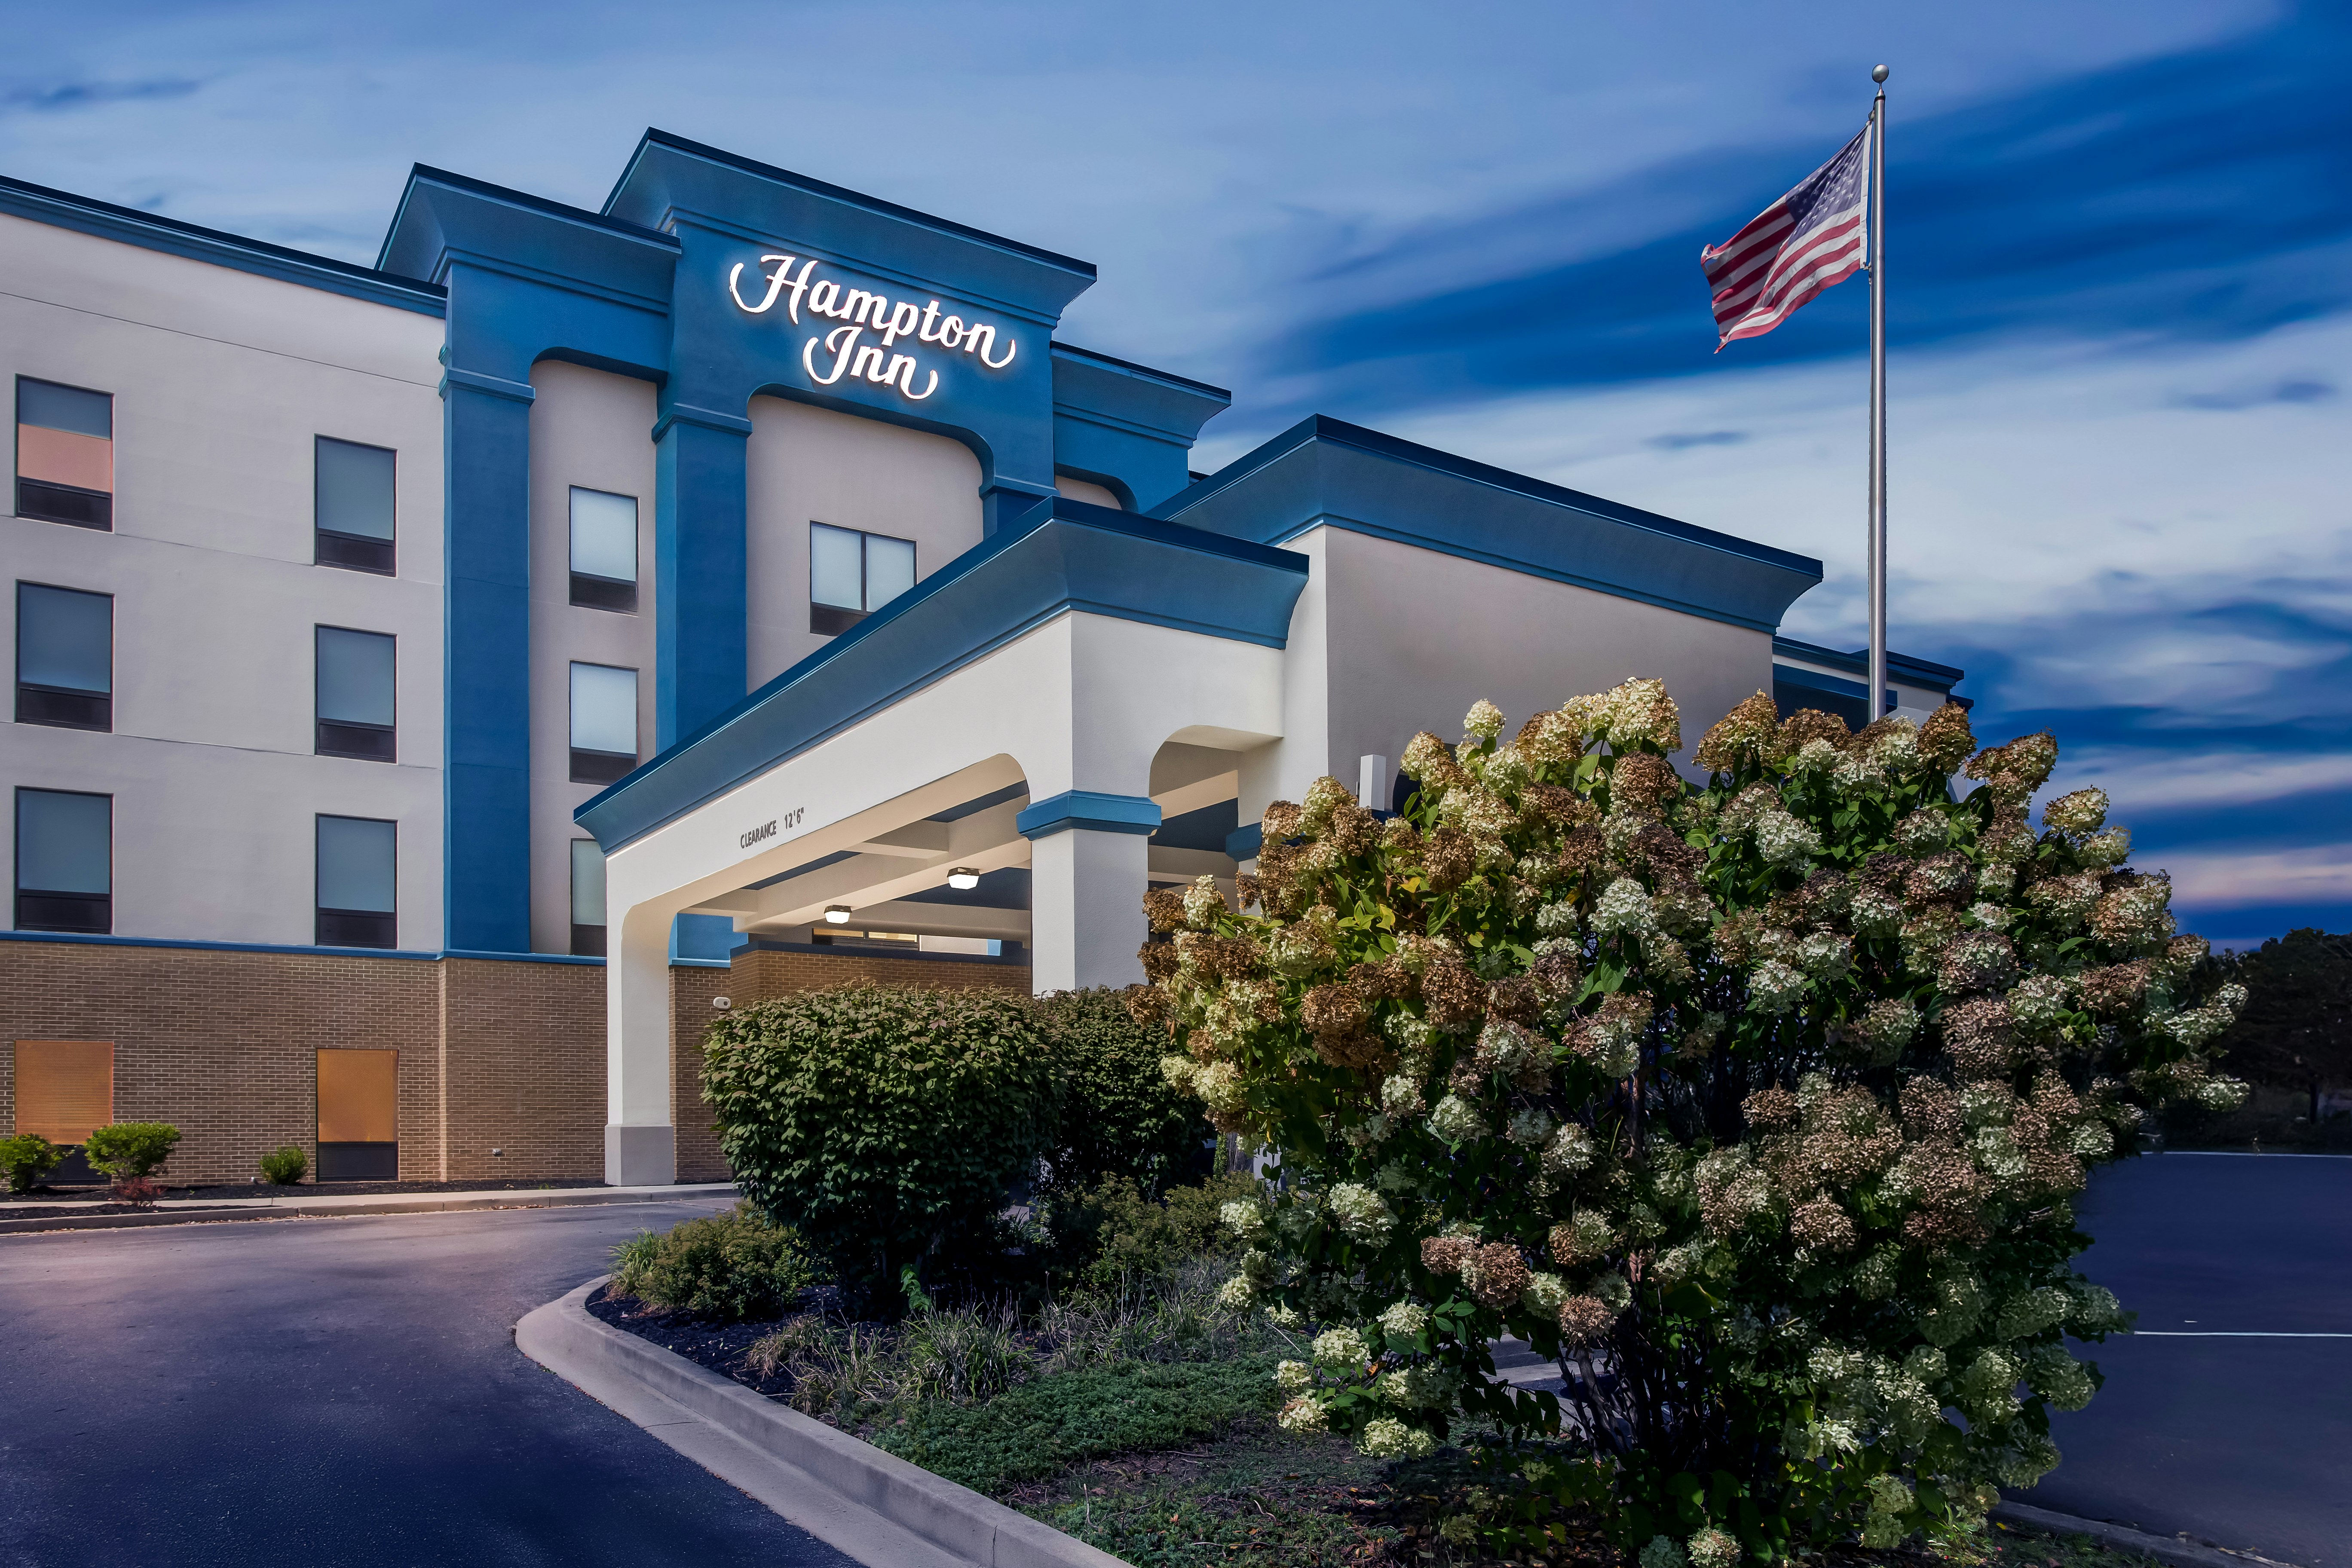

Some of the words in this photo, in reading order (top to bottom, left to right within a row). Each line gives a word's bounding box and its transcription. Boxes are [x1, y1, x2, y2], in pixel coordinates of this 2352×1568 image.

[730, 254, 1016, 368] Hampton
[803, 326, 938, 399] Inn
[740, 820, 777, 849] CLEARANCE
